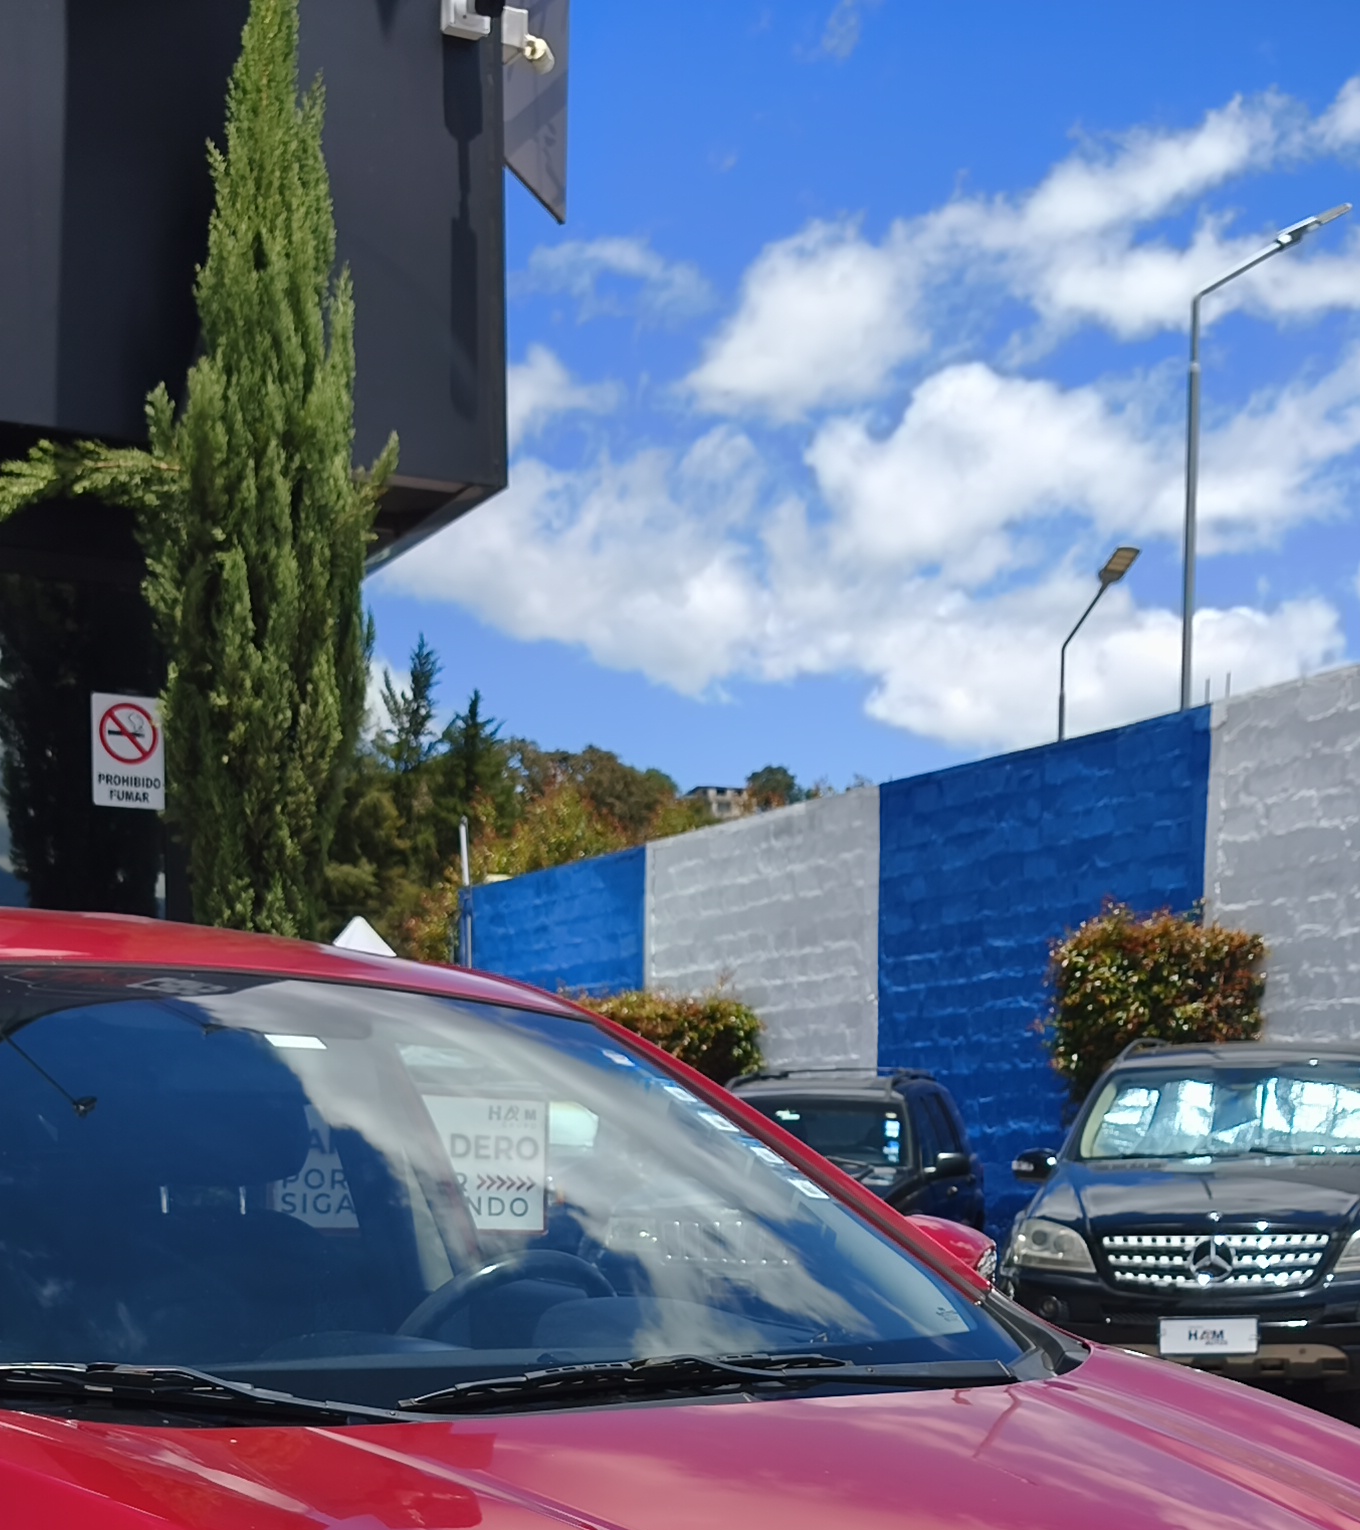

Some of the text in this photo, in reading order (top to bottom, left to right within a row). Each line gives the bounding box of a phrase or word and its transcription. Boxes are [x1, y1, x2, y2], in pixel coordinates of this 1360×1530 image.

[98, 773, 161, 789] PROHIBIDO
[109, 789, 150, 803] FUMAR
[281, 1192, 357, 1215] SIGA
